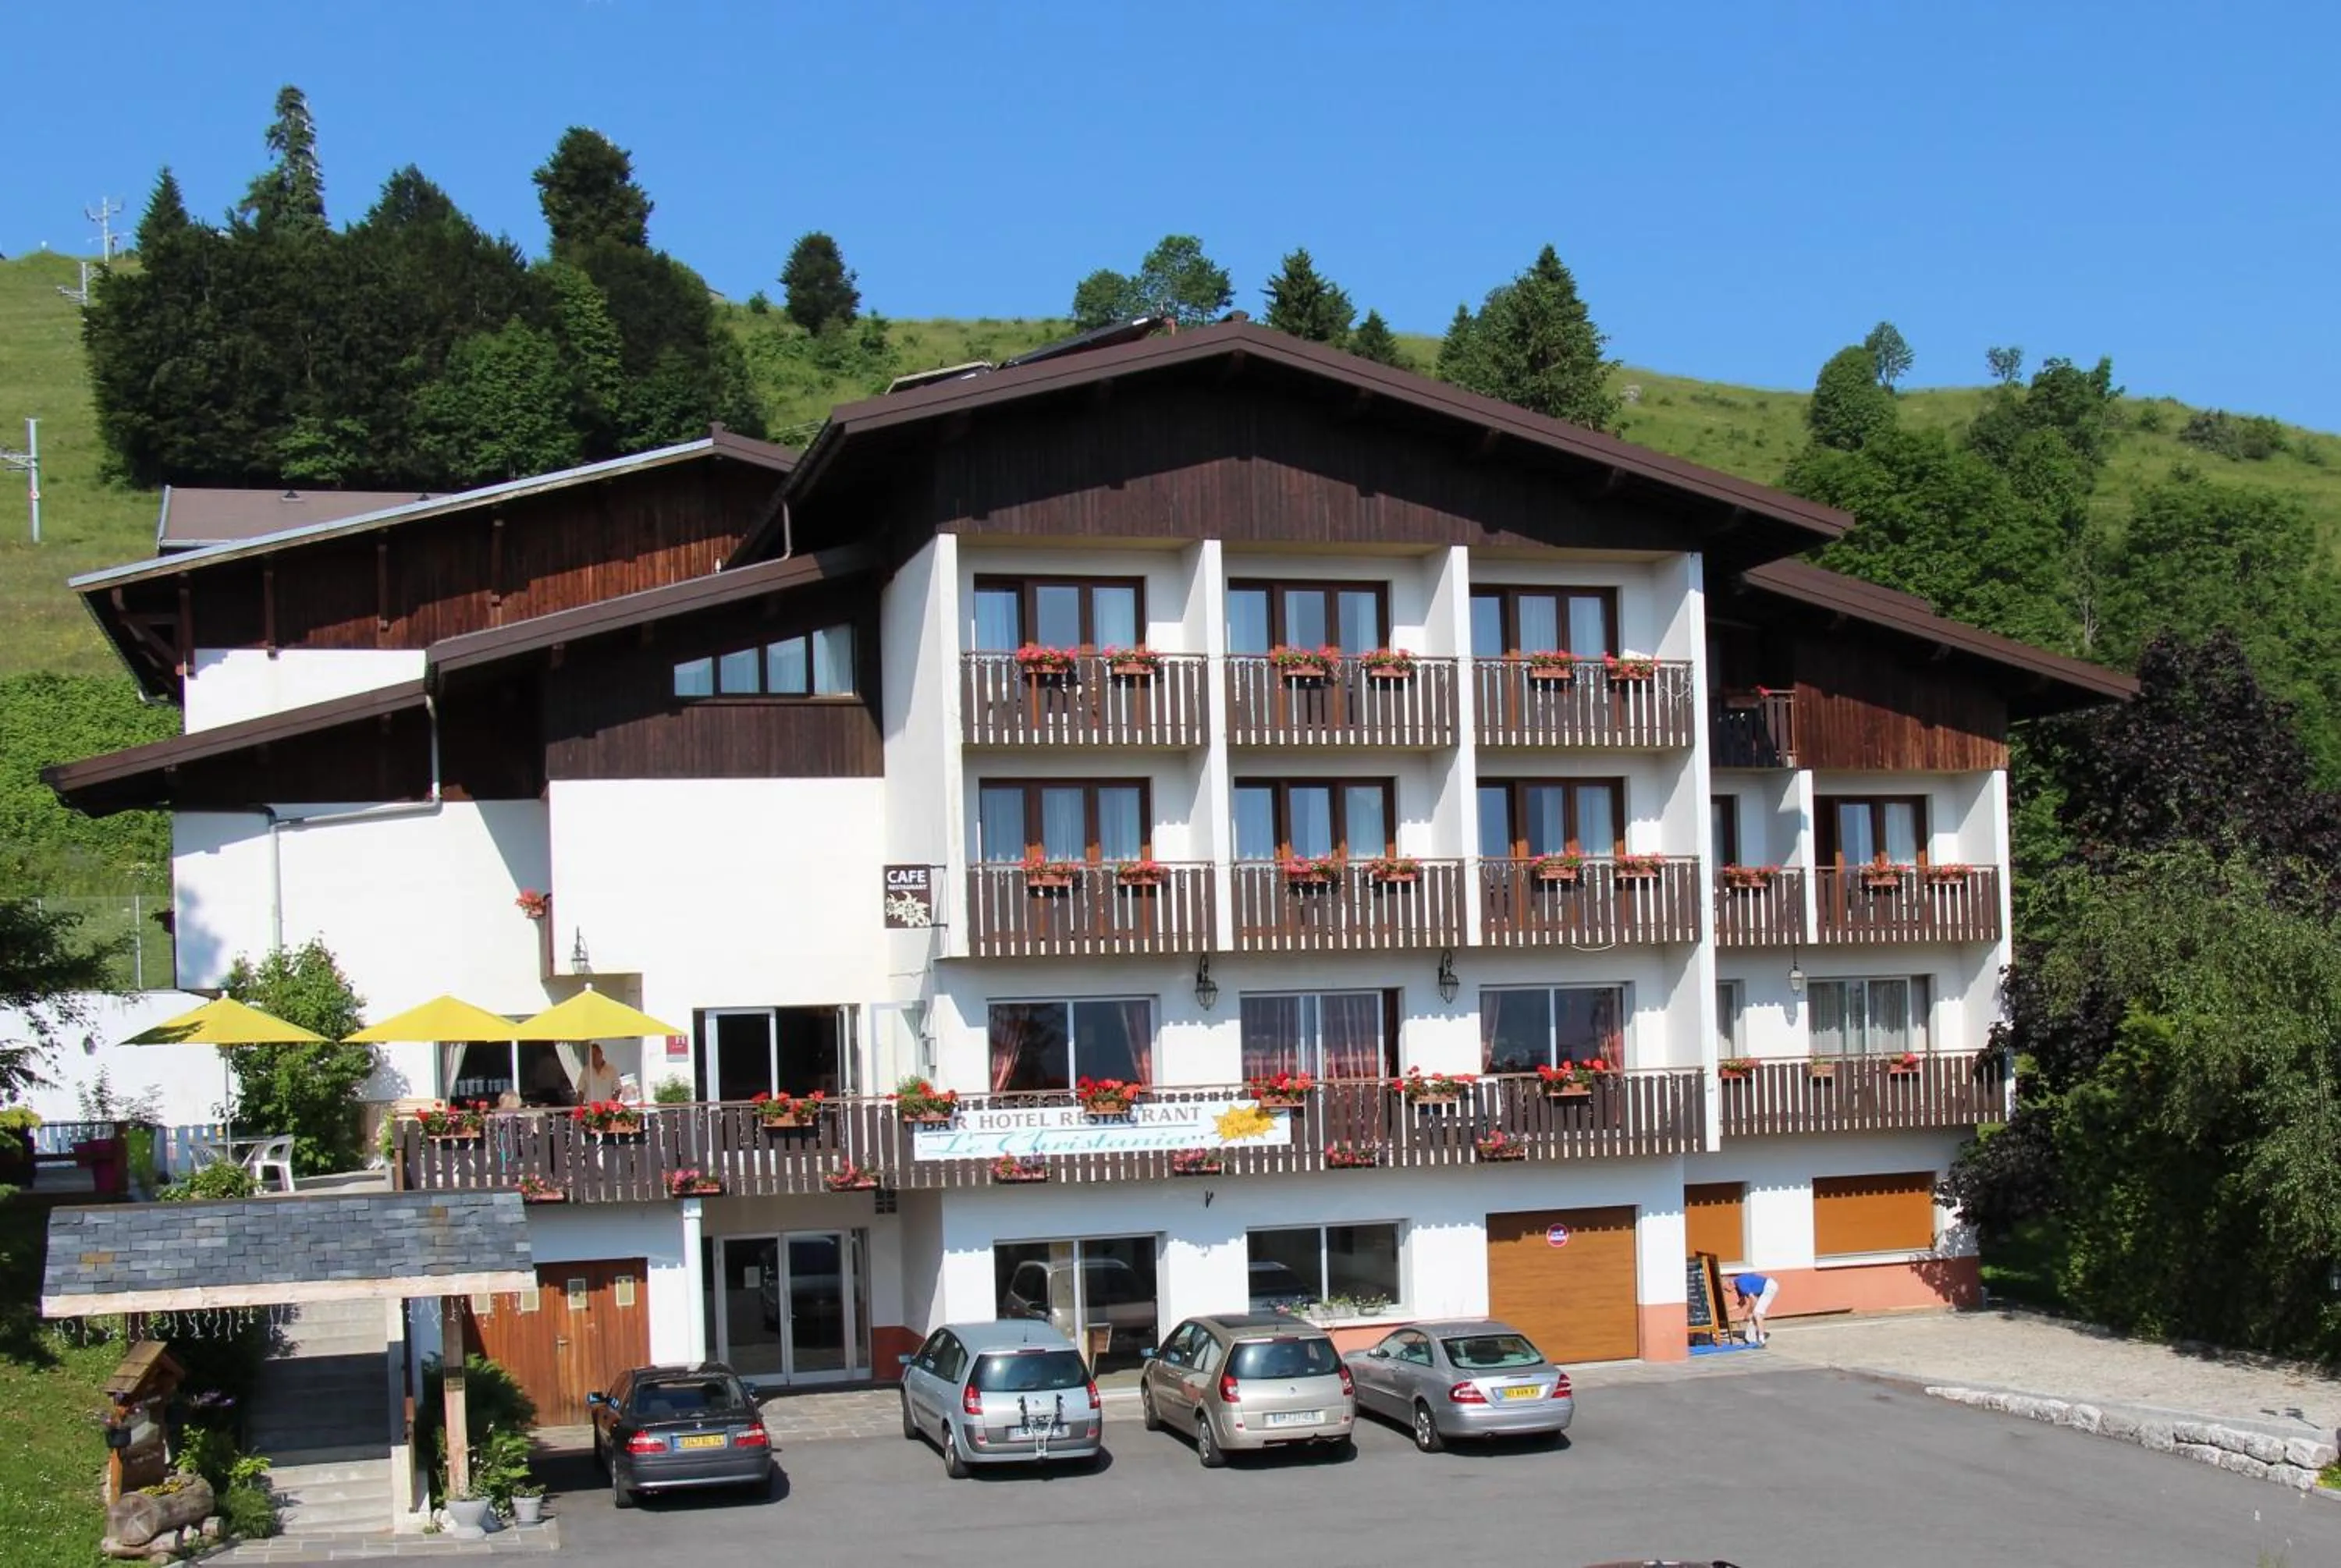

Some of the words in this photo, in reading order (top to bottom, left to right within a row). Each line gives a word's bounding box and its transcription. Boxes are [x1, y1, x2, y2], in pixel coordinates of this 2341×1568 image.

[887, 870, 926, 883] CAFE
[923, 1116, 968, 1131] BAR
[979, 1112, 1050, 1129] HOTEL
[1060, 1107, 1202, 1126] RESTAURANT
